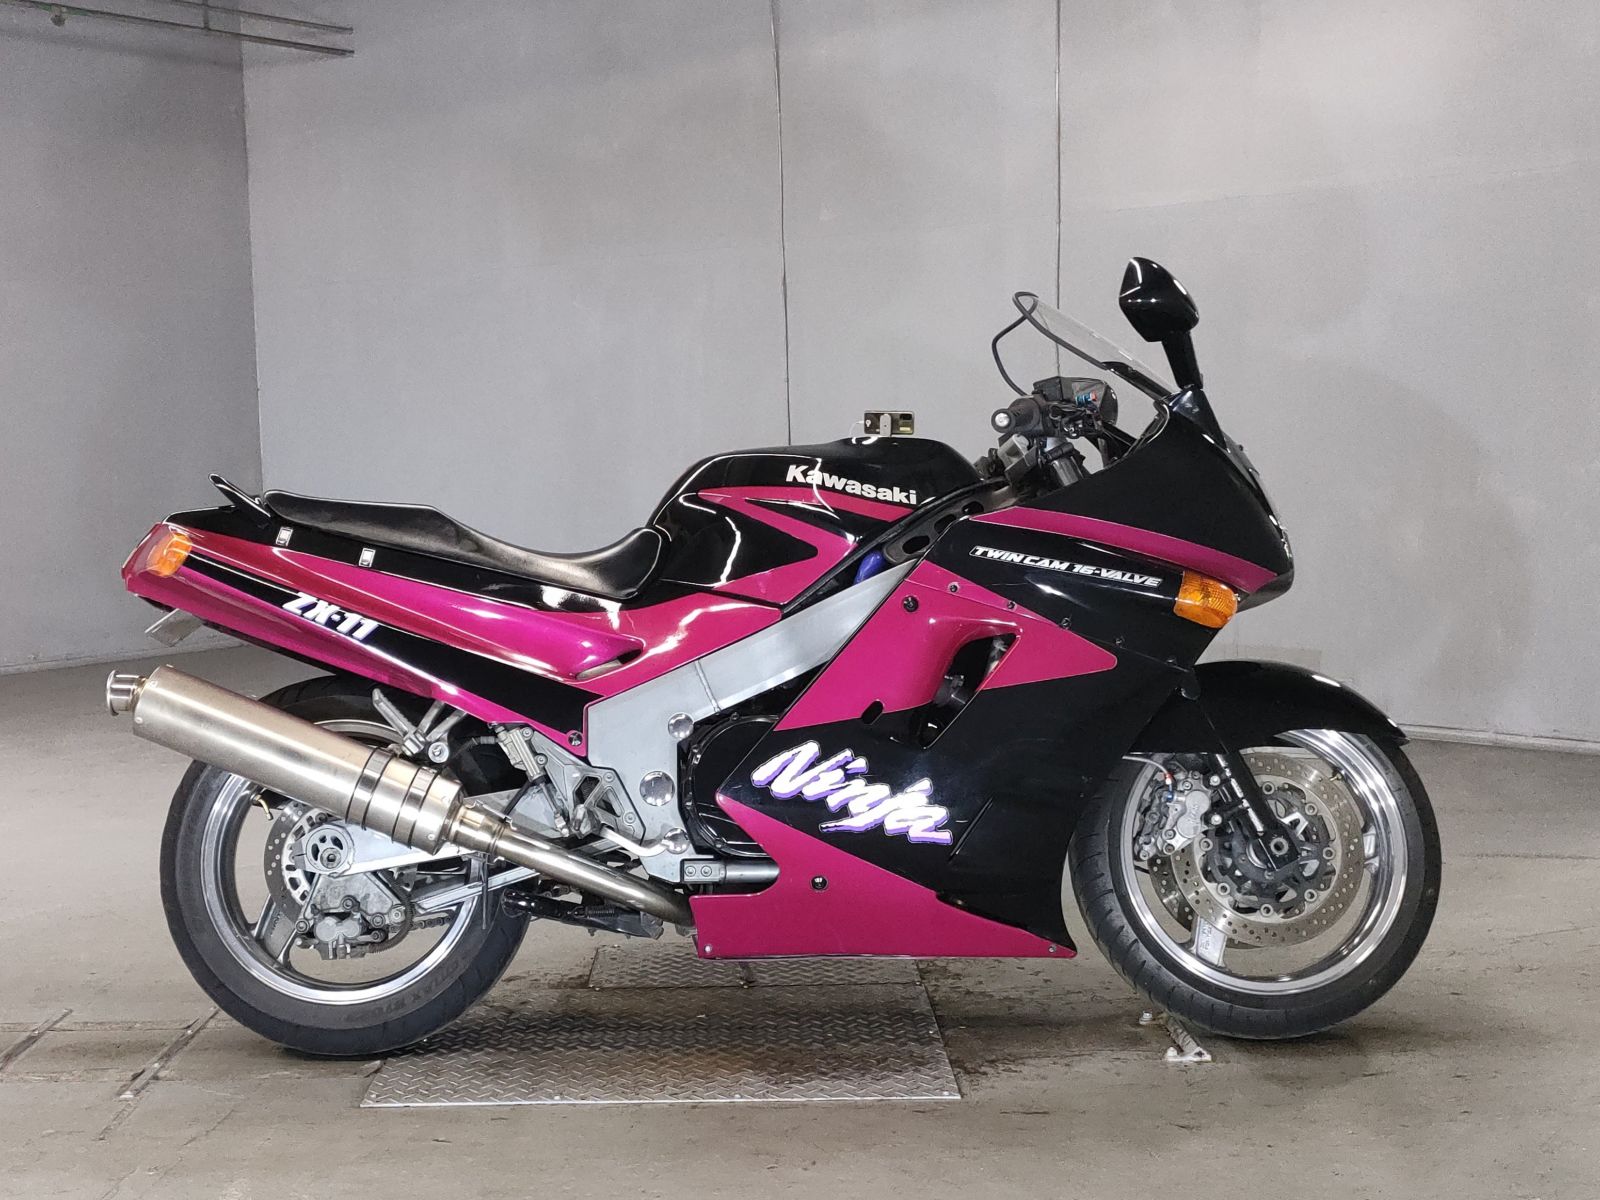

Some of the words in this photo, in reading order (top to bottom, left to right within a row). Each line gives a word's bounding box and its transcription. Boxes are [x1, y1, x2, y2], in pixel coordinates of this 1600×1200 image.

[785, 464, 917, 505] Kawasaki
[974, 546, 1025, 563] TWIN
[1022, 556, 1070, 571] CAM
[1071, 564, 1163, 587] 16-VALVE
[281, 591, 379, 641] ZX-11
[751, 739, 954, 845] Ninja
